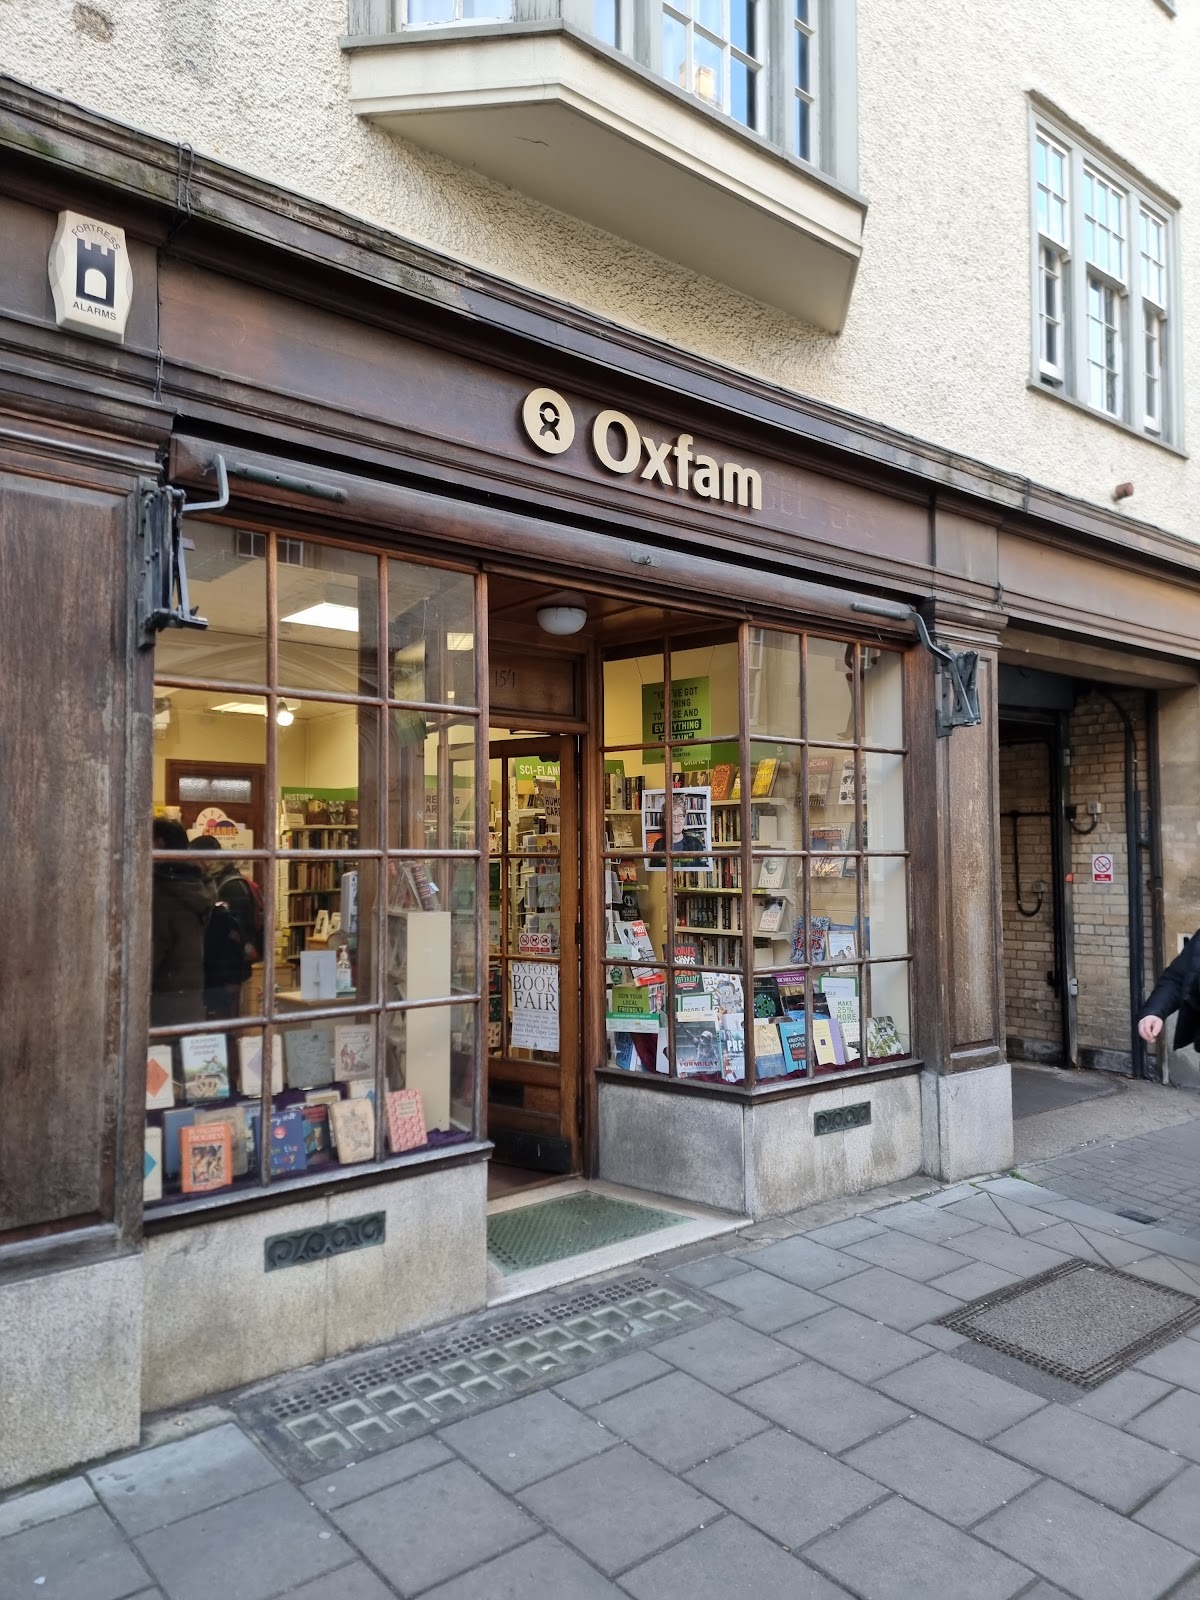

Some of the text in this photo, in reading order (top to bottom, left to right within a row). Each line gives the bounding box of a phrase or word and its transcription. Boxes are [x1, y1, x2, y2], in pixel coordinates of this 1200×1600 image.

[71, 223, 121, 251] FORTRESS
[72, 301, 117, 321] ALARMS
[592, 409, 763, 511] Oxfam
[684, 686, 699, 697] GOT
[660, 698, 691, 710] NHING
[653, 712, 662, 720] TO
[683, 708, 699, 718] AND
[654, 720, 700, 733] EVYTHING
[519, 765, 545, 775] SCI-FI
[284, 793, 314, 802] HISTORY
[203, 826, 239, 837] CHANGE
[511, 963, 558, 976] OXFORD
[512, 974, 558, 993] BOOK
[513, 990, 558, 1012] FAIR
[836, 1013, 857, 1021] MORE
[726, 1040, 744, 1052] PRE
[679, 1060, 714, 1068] FORMULA
